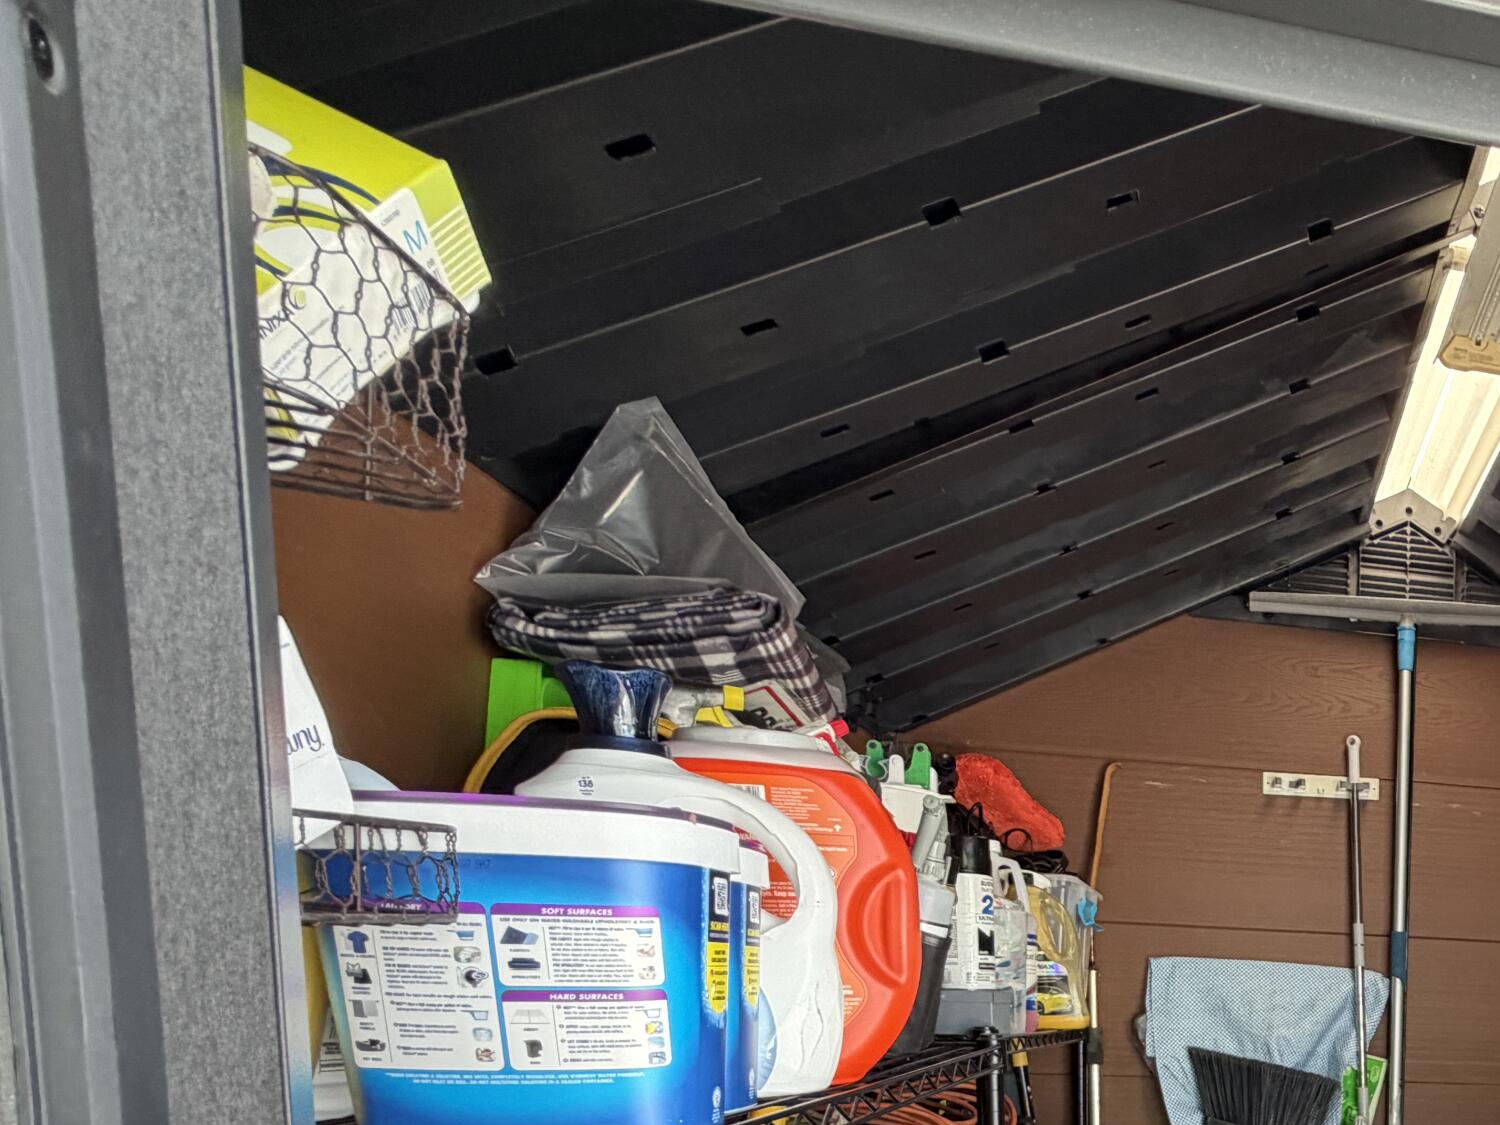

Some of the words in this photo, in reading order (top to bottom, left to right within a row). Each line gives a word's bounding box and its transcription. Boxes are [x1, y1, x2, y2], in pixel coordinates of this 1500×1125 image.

[402, 219, 428, 255] M
[541, 907, 564, 915] SOFT
[567, 908, 613, 916] SURFACES
[579, 993, 624, 1001] SURFACES
